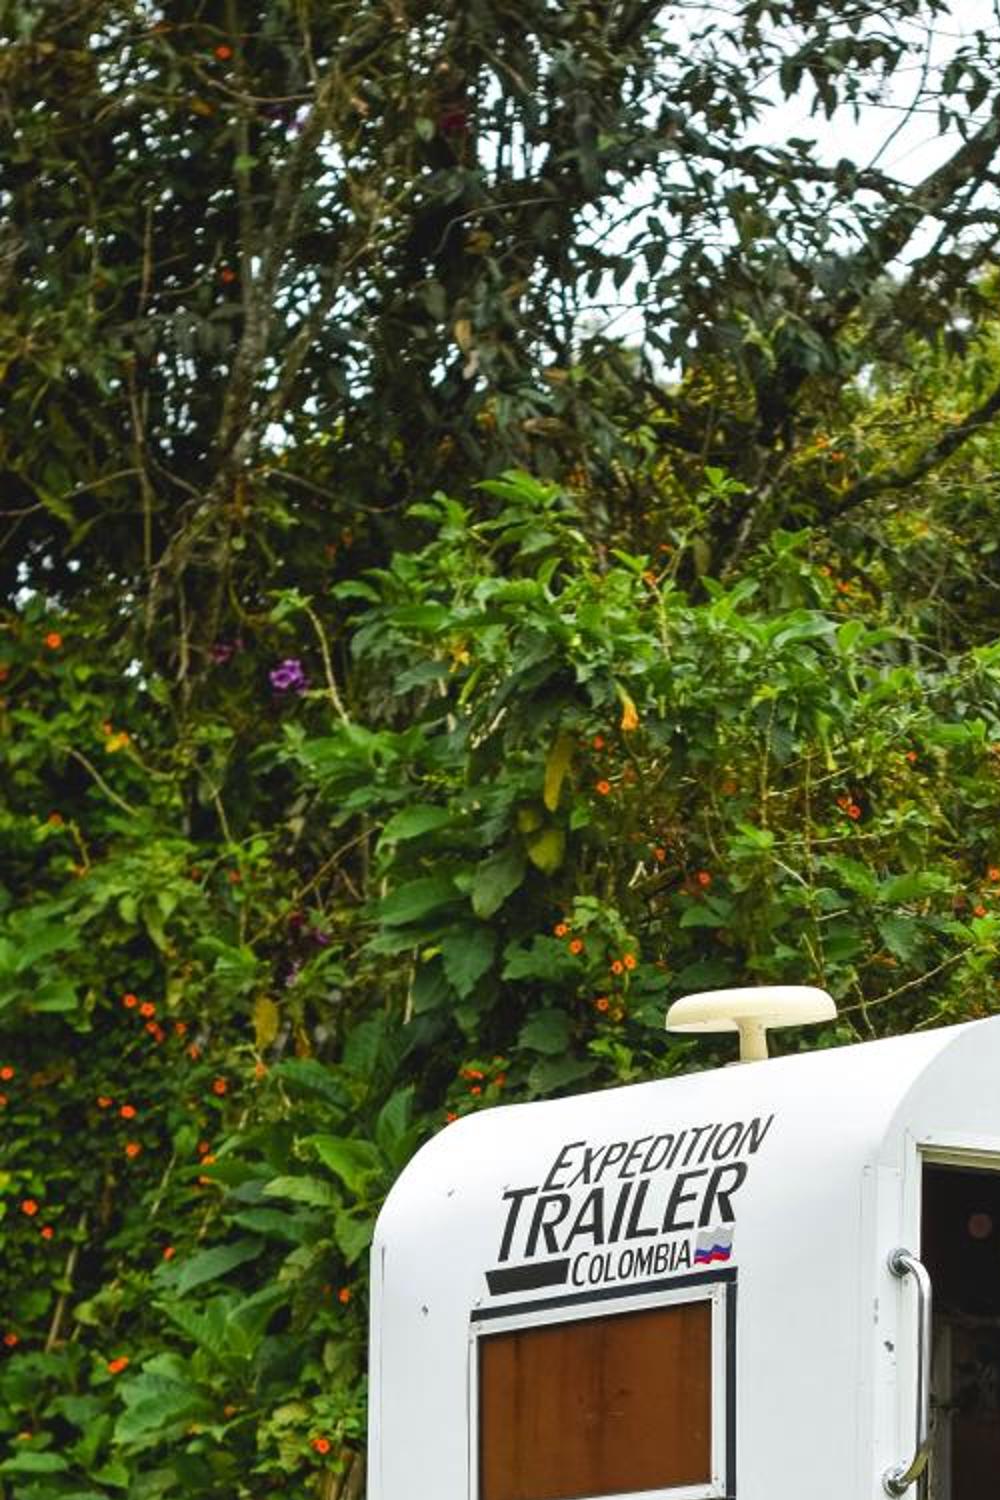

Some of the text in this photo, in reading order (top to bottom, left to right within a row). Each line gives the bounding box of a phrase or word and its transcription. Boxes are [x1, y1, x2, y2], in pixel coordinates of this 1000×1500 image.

[541, 1113, 775, 1193] EXPEDITION
[497, 1161, 749, 1263] TRAILER
[570, 1239, 692, 1287] COLOMBIA
